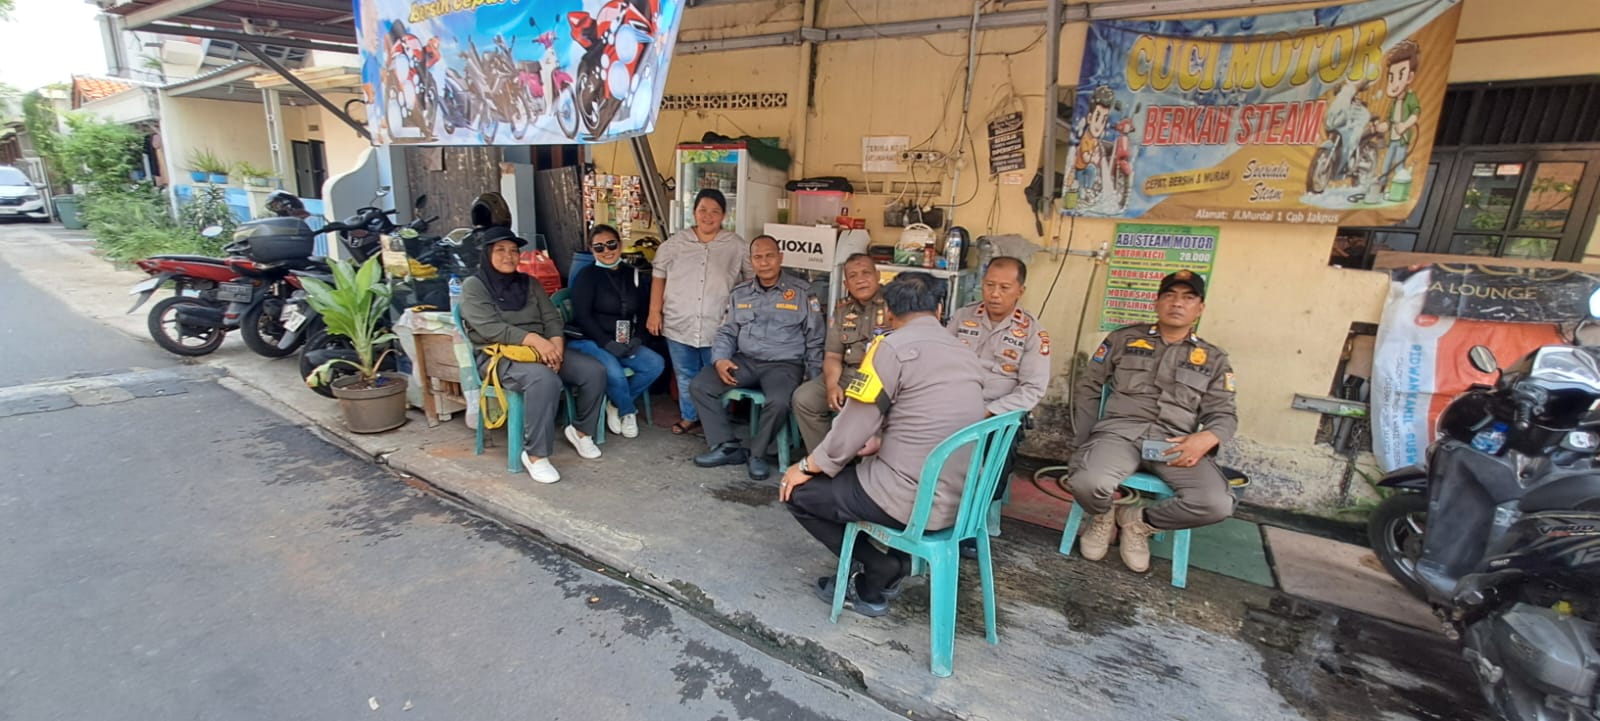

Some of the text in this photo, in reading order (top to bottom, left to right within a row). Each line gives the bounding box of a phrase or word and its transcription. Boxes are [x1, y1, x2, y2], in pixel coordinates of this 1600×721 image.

[1127, 19, 1387, 92] CUCI MOTOR
[1141, 101, 1325, 146] BERKAH STEAM
[1203, 170, 1230, 183] MURAH
[1249, 182, 1283, 203] Steam
[1195, 209, 1228, 219] Alamat:
[1277, 211, 1282, 220] 1
[1306, 211, 1339, 224] Jakpus
[1115, 234, 1214, 249] ABI STEAM MOTOR
[1114, 250, 1210, 262] MOTOR KECIL 20.000
[1111, 269, 1166, 280] MOTOR BESAR
[1108, 289, 1158, 300] MOTOR SPOR
[1429, 281, 1537, 300] A LOUNGE
[1106, 300, 1155, 311] FULL FAIRING
[1403, 392, 1418, 424] KAMIL
[1406, 433, 1418, 464] SUSW
